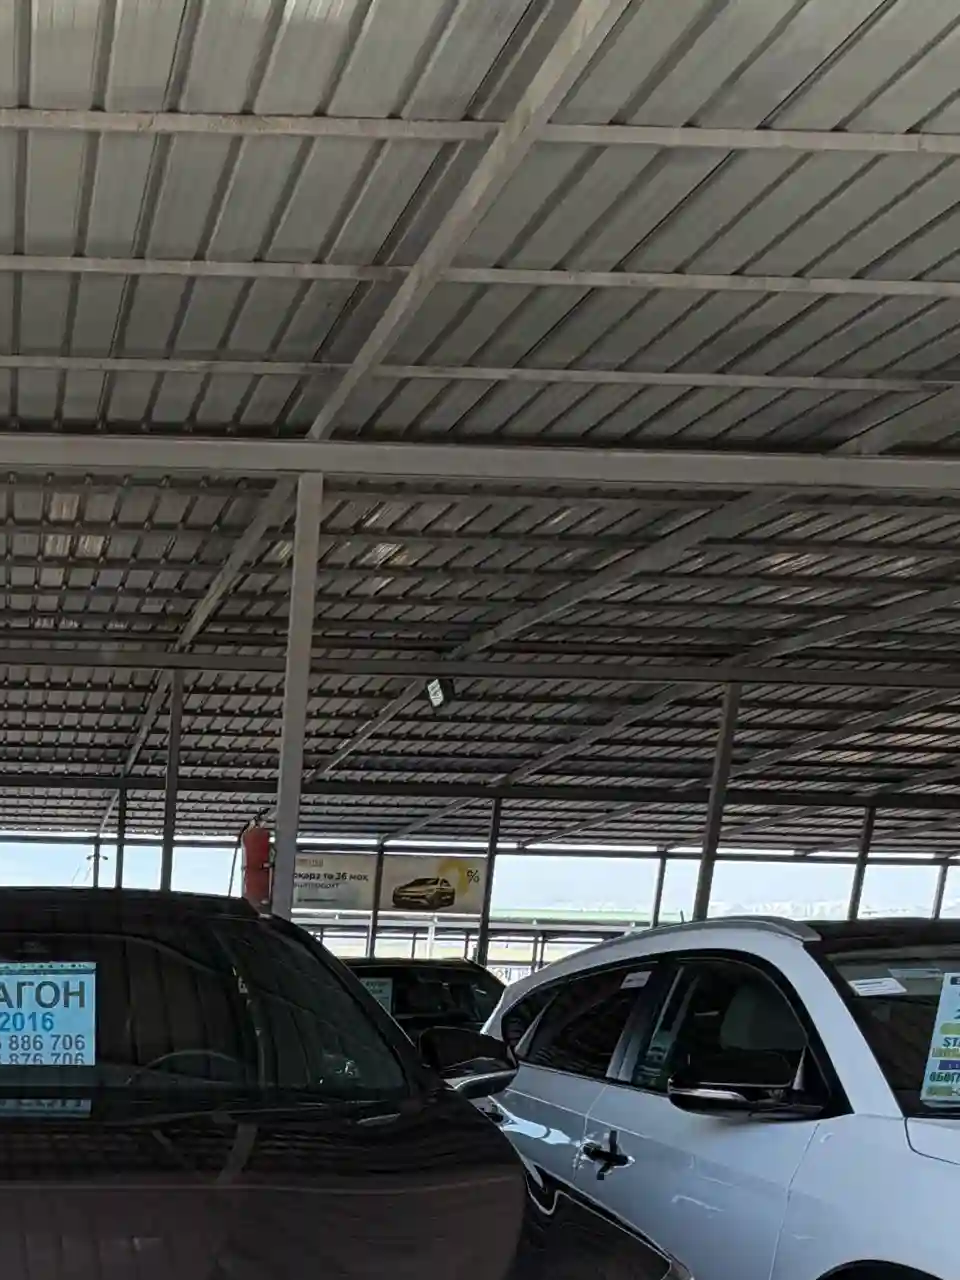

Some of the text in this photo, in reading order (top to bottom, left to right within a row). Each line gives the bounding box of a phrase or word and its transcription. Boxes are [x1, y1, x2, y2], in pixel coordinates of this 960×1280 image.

[8, 1034, 44, 1051] 886
[51, 1034, 86, 1051] 706
[8, 1053, 44, 1065] 876
[51, 1053, 85, 1065] 706
